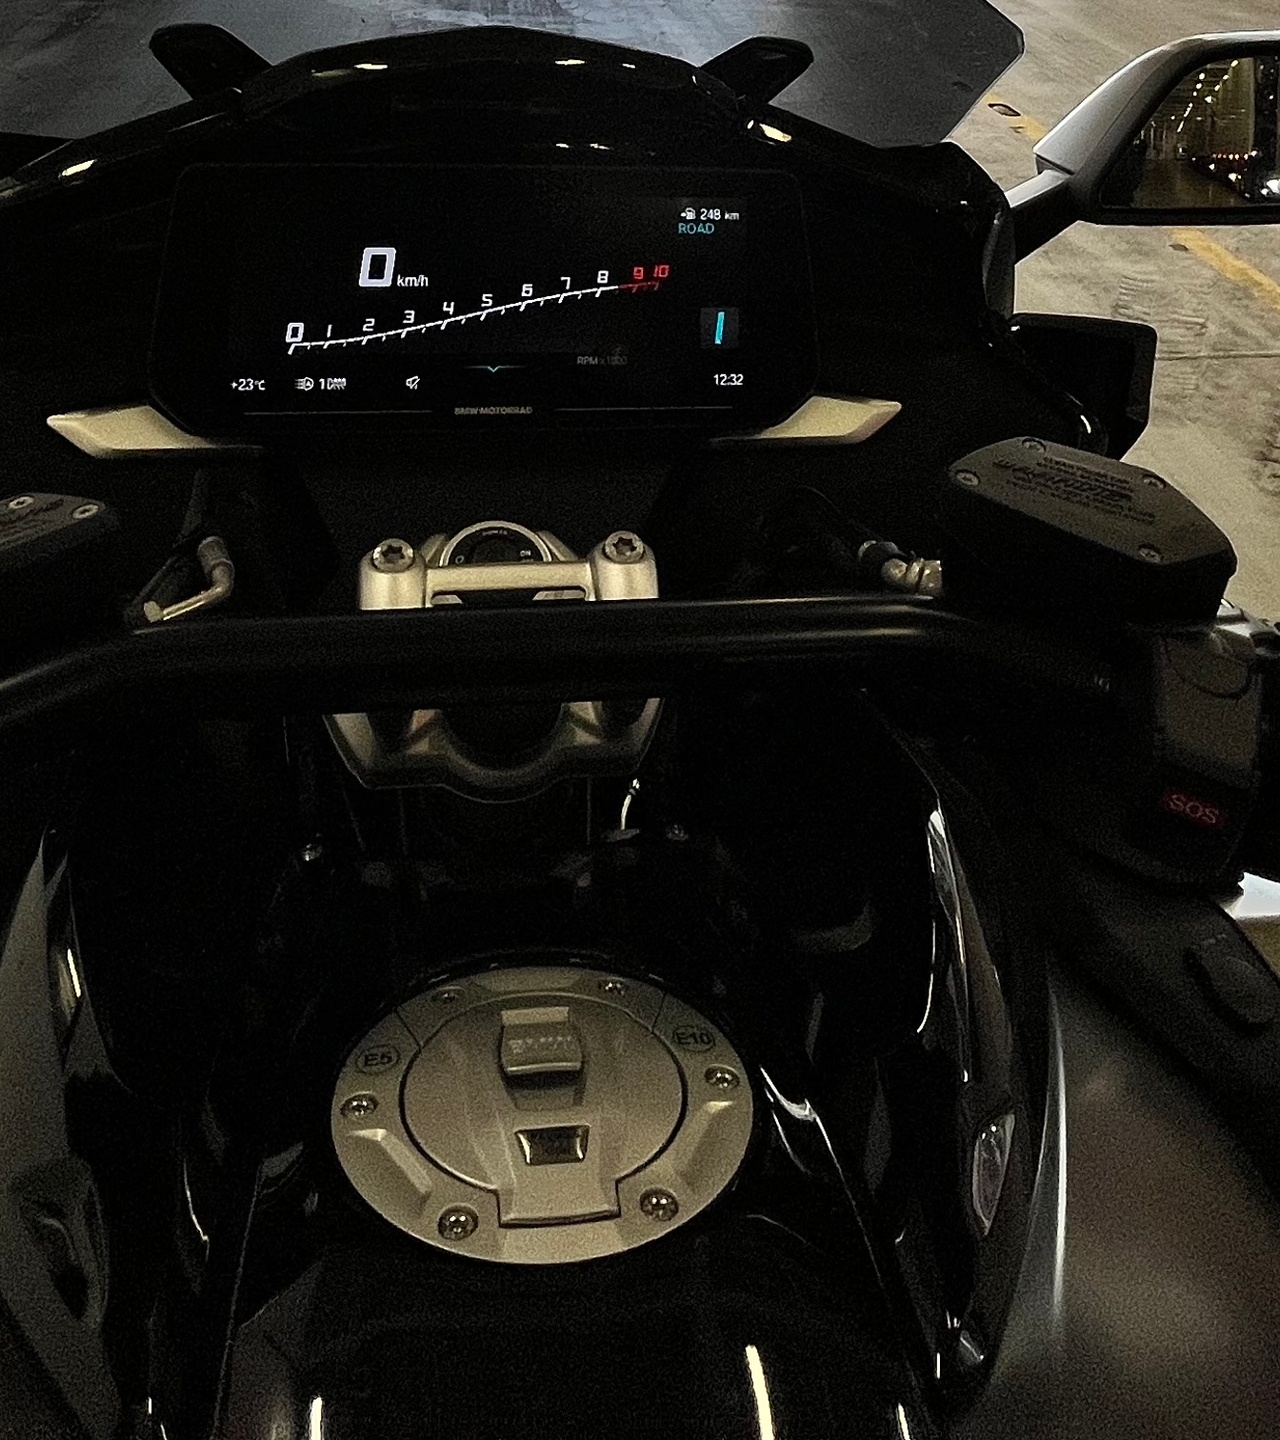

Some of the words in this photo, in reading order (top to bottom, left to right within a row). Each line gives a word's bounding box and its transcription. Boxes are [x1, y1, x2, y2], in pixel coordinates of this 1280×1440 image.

[700, 208, 721, 220] 248
[724, 210, 740, 221] km
[677, 222, 715, 235] ROAD
[358, 246, 397, 288] 0
[396, 273, 429, 288] km/h
[285, 322, 305, 343] 0
[326, 324, 333, 338] 1
[362, 317, 375, 332] 2
[402, 309, 416, 324] 3
[442, 301, 455, 315] 4
[480, 293, 493, 308] 5
[521, 283, 533, 297] 6
[560, 276, 571, 290] 7
[597, 269, 609, 284] 8
[633, 266, 645, 280] 9
[653, 264, 670, 278] 10
[576, 355, 599, 365] RPM
[453, 406, 478, 416] BMW
[478, 405, 534, 416] MOTORRAD
[1169, 793, 1220, 824] SOS
[676, 1031, 711, 1046] E10
[363, 1051, 394, 1068] E5
